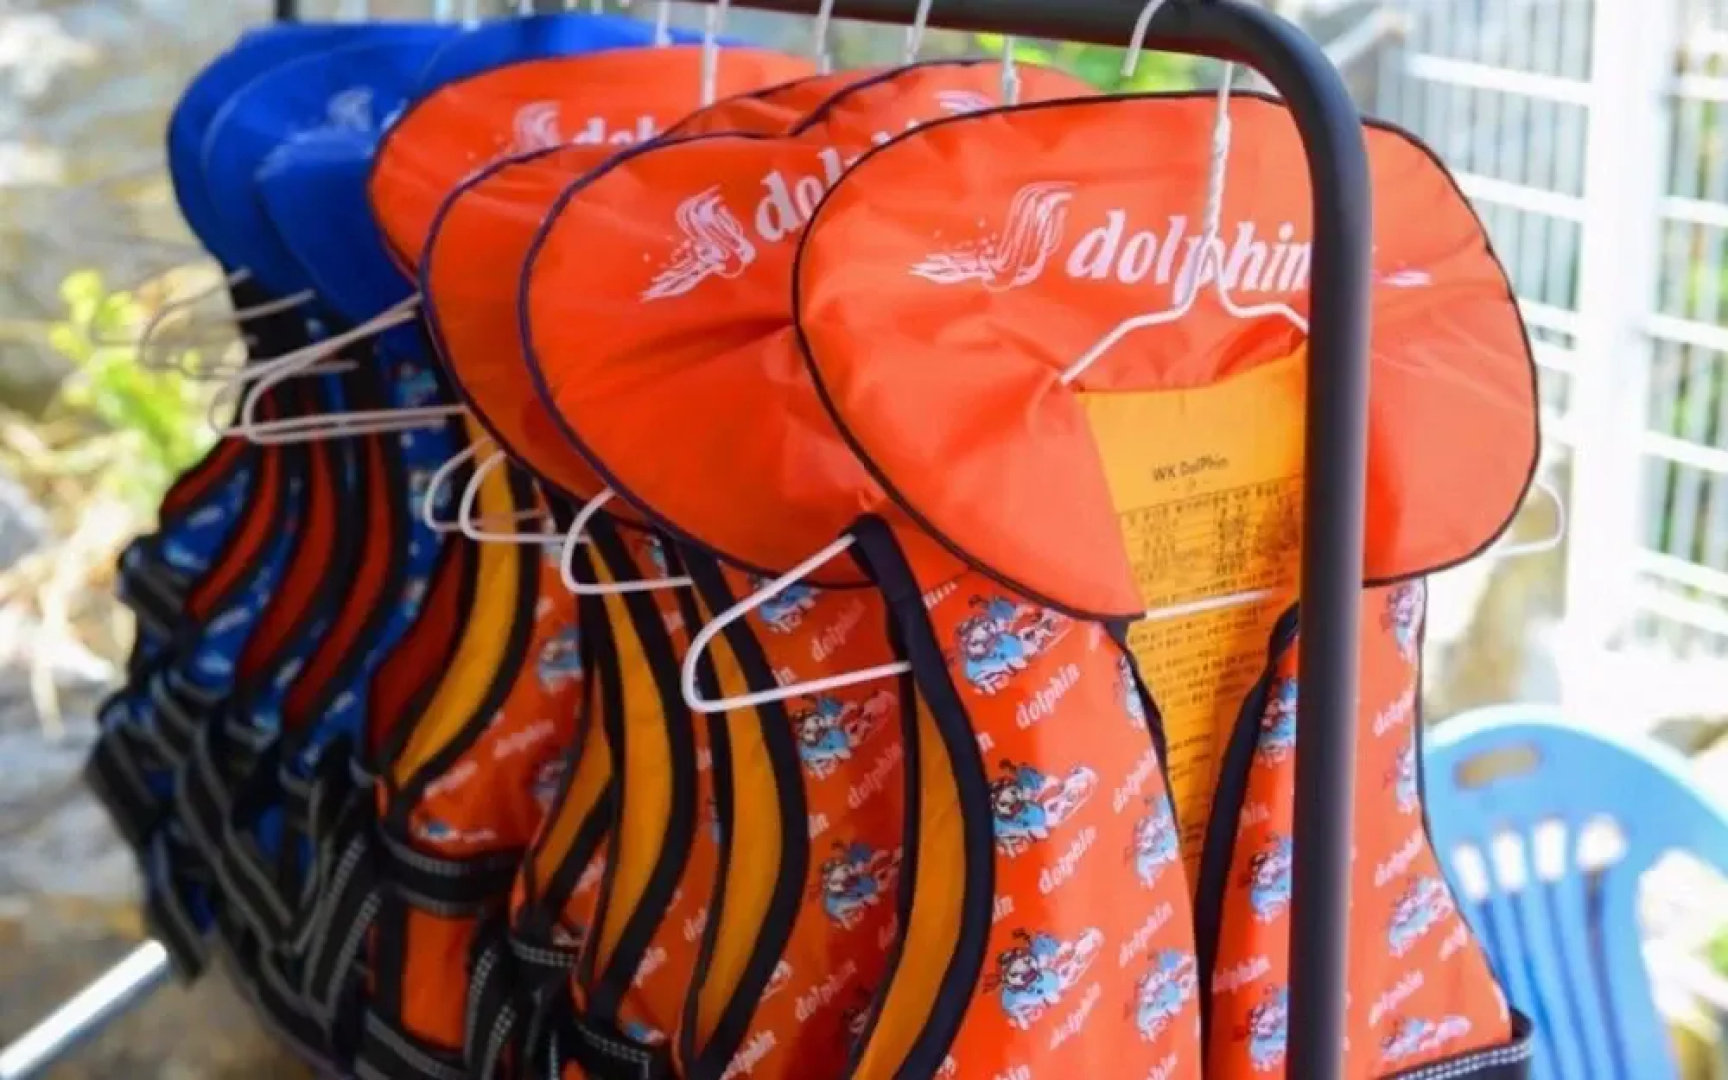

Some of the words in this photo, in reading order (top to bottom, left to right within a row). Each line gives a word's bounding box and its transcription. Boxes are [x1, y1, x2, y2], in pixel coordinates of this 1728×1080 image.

[1066, 209, 1312, 308] dolphin
[1016, 662, 1081, 729] dolphin
[1038, 826, 1097, 894] dolphin
